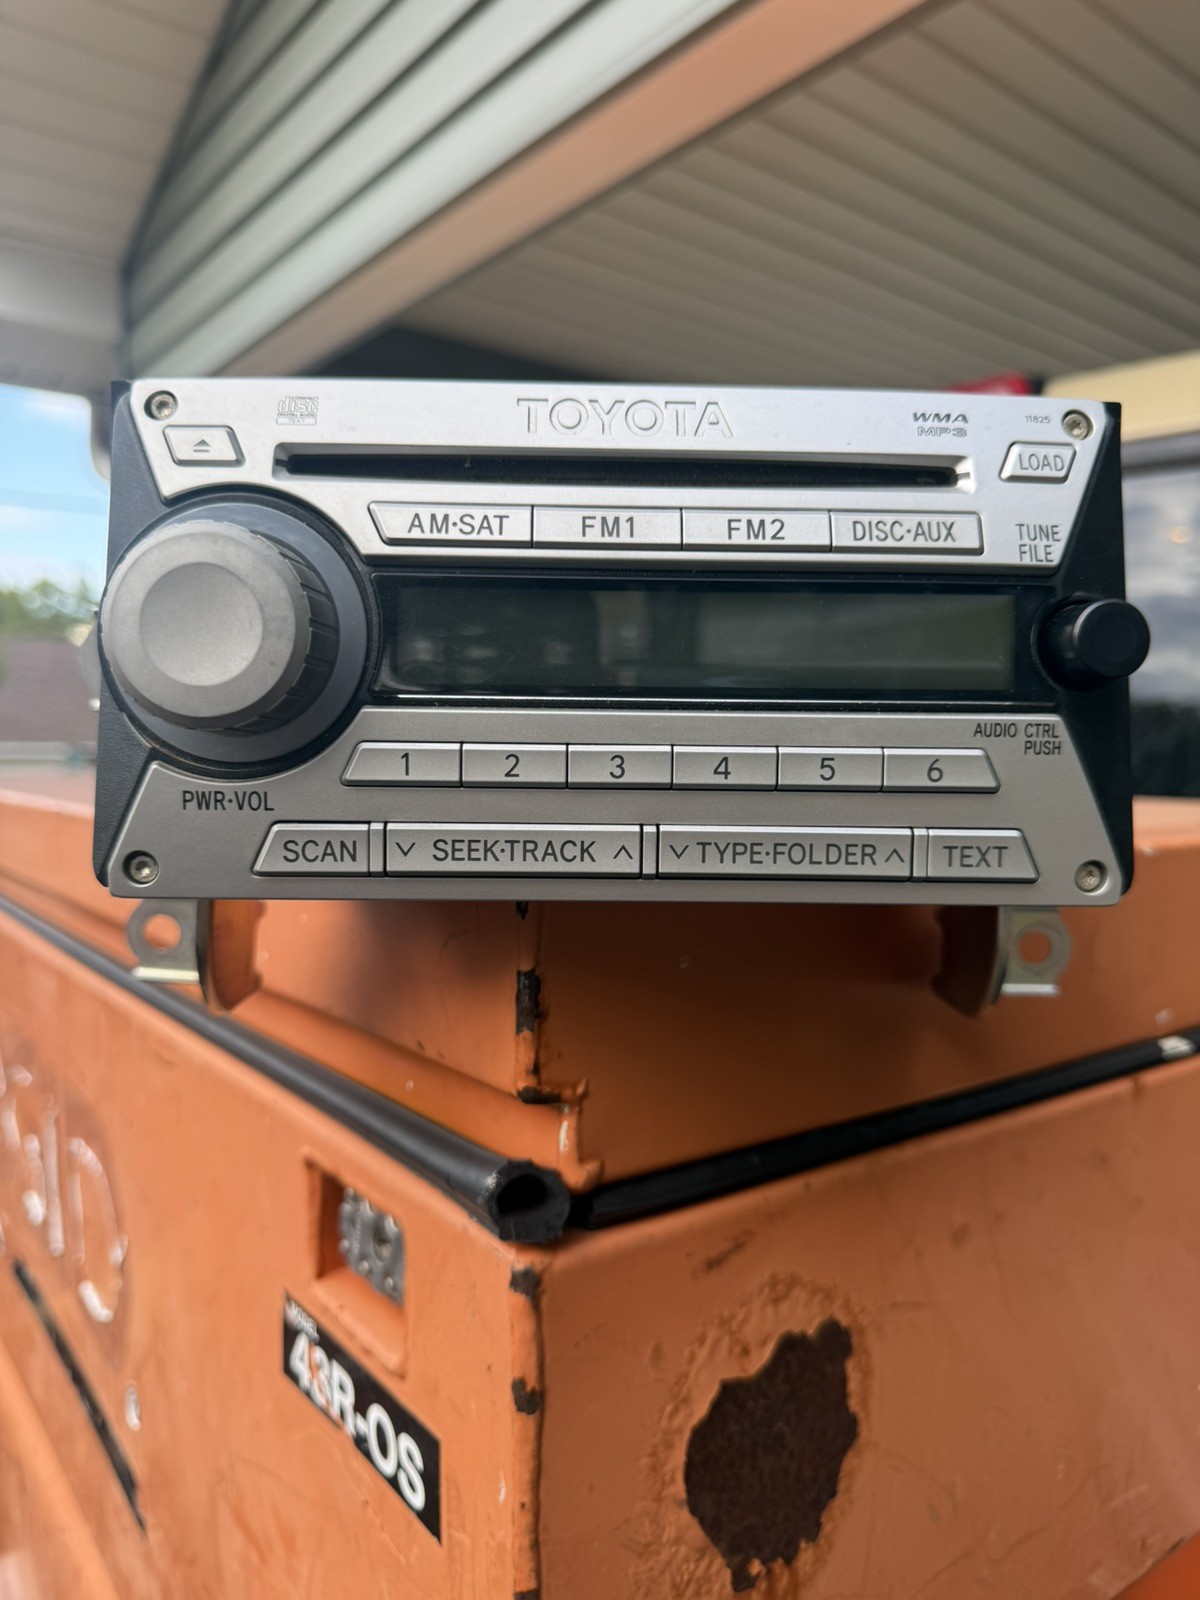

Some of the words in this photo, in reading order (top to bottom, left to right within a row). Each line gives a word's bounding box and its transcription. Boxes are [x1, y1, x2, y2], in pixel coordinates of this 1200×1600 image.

[517, 398, 734, 437] TOYOTA
[912, 412, 970, 425] WMA
[1024, 414, 1051, 425] 11825
[916, 426, 968, 439] MP3
[1018, 452, 1065, 473] LOAD
[581, 516, 636, 539] FM1
[727, 519, 786, 541] FM2
[1015, 523, 1061, 543] TUNE
[1018, 543, 1055, 563] FILE
[972, 721, 1018, 739] AUDIO
[1023, 723, 1060, 740] CTRL
[1023, 740, 1062, 756] PUSH
[400, 752, 411, 776] 1
[503, 753, 521, 778] 2
[608, 754, 626, 779] 3
[712, 756, 732, 780] 4
[819, 757, 837, 782] 5
[926, 758, 944, 783] 6
[281, 839, 359, 863] SCAN
[942, 845, 1009, 868] TEXT
